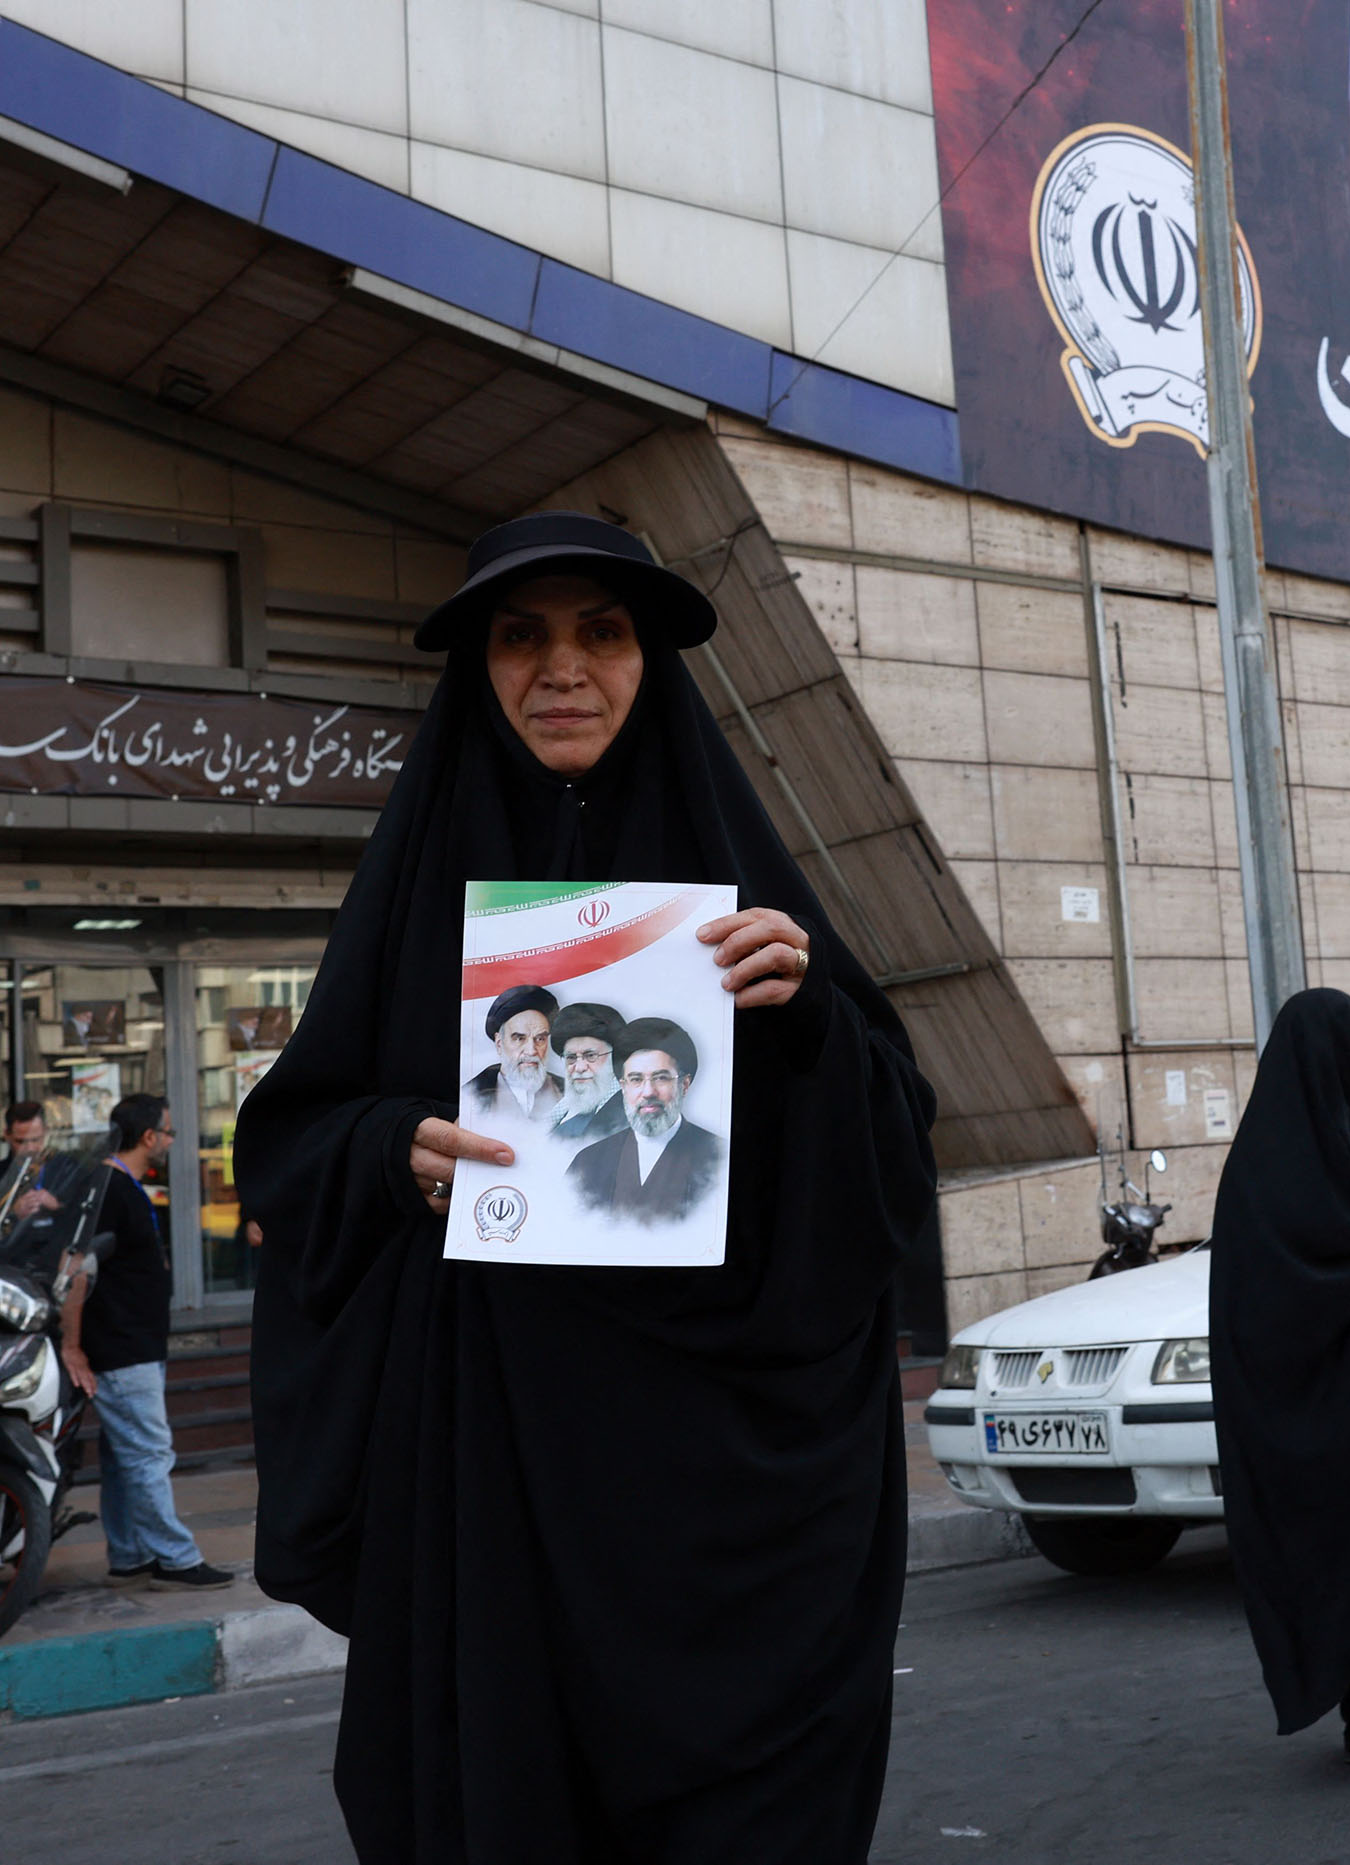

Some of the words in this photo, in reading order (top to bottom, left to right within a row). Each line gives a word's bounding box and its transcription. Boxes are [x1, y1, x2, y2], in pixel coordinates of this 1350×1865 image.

[44, 694, 141, 785] بانک
[124, 717, 208, 767] شهدای
[204, 732, 281, 800] پذیرایی
[282, 735, 297, 757] و
[287, 704, 350, 787] فرهنگی
